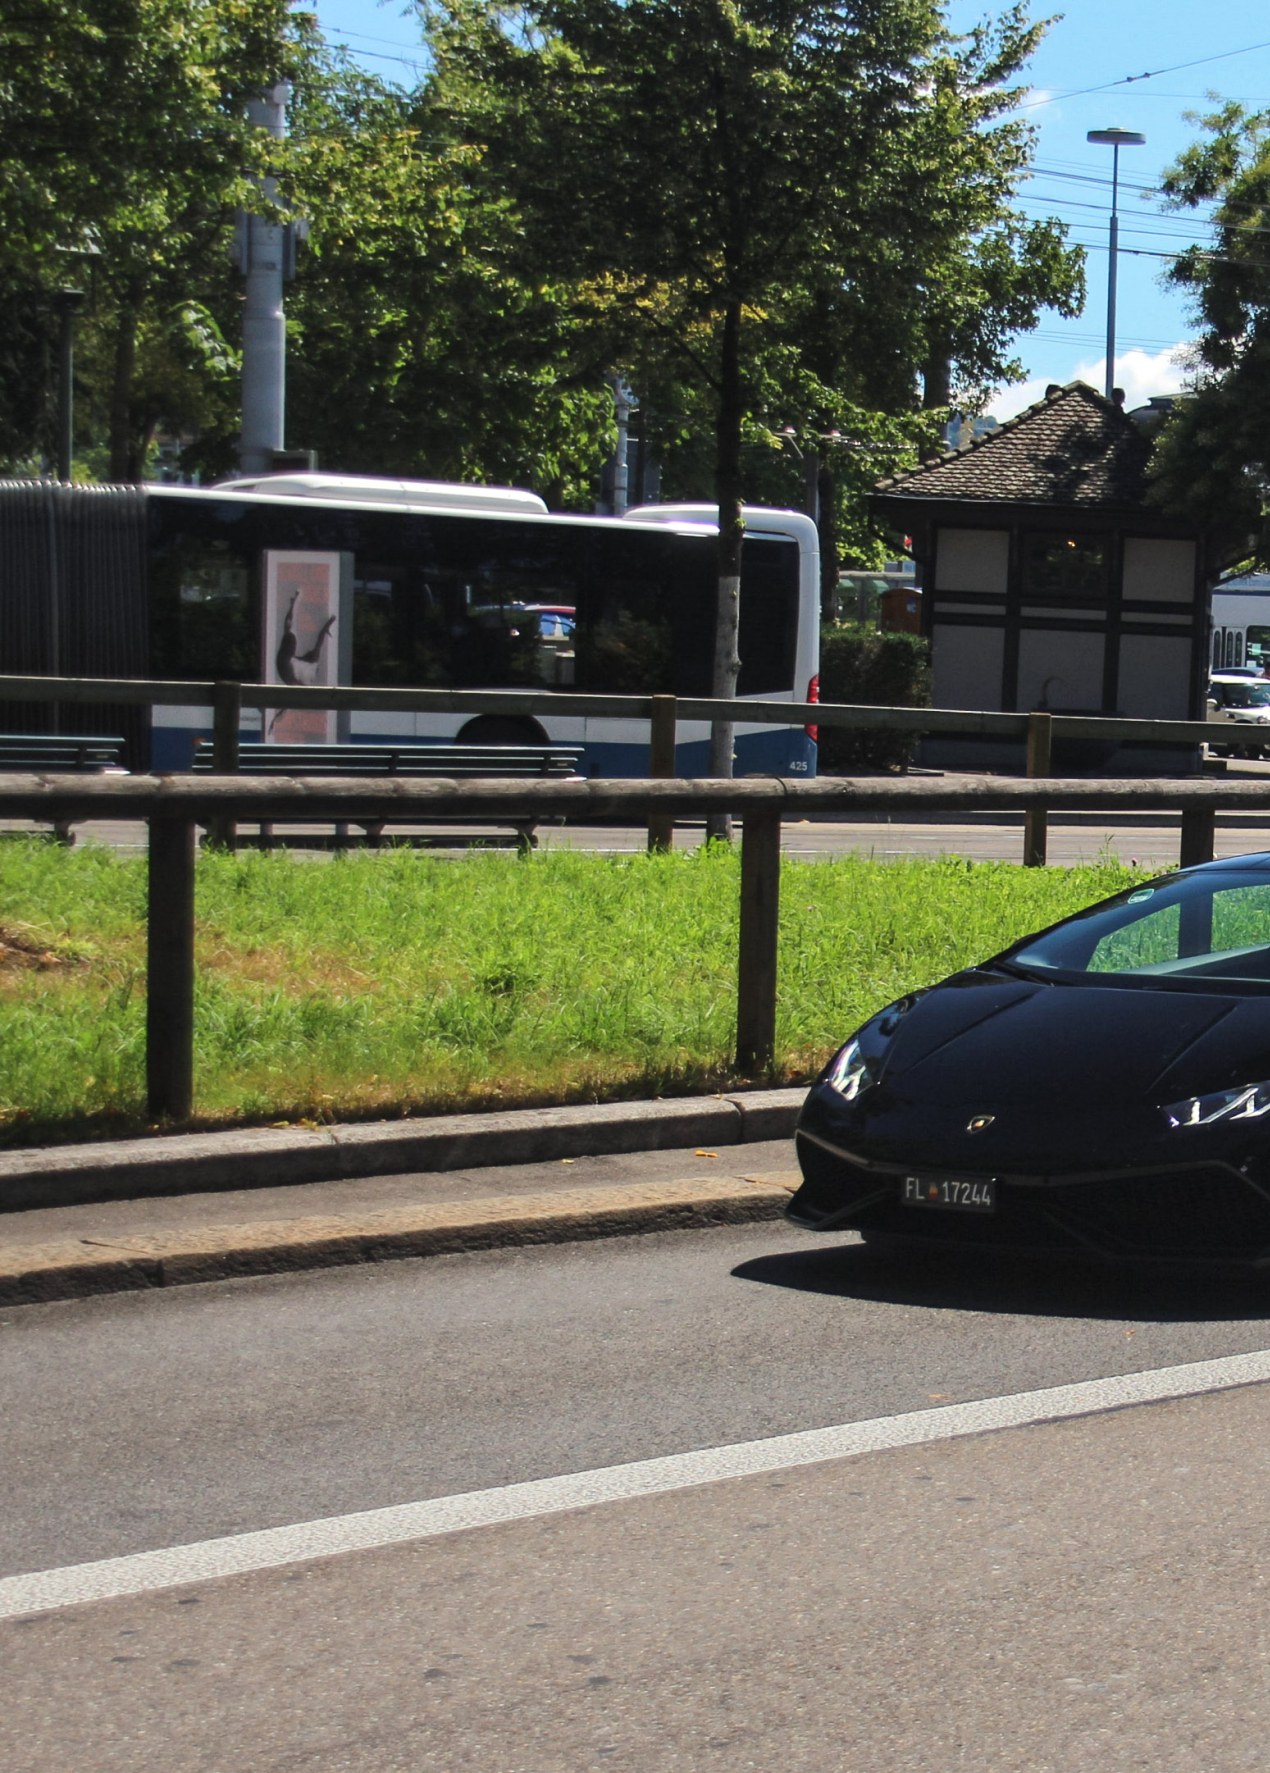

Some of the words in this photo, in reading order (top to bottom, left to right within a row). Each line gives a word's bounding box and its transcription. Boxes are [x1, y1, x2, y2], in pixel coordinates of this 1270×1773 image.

[789, 761, 808, 771] 425
[906, 1177, 925, 1200] FL
[942, 1181, 991, 1206] 17244
